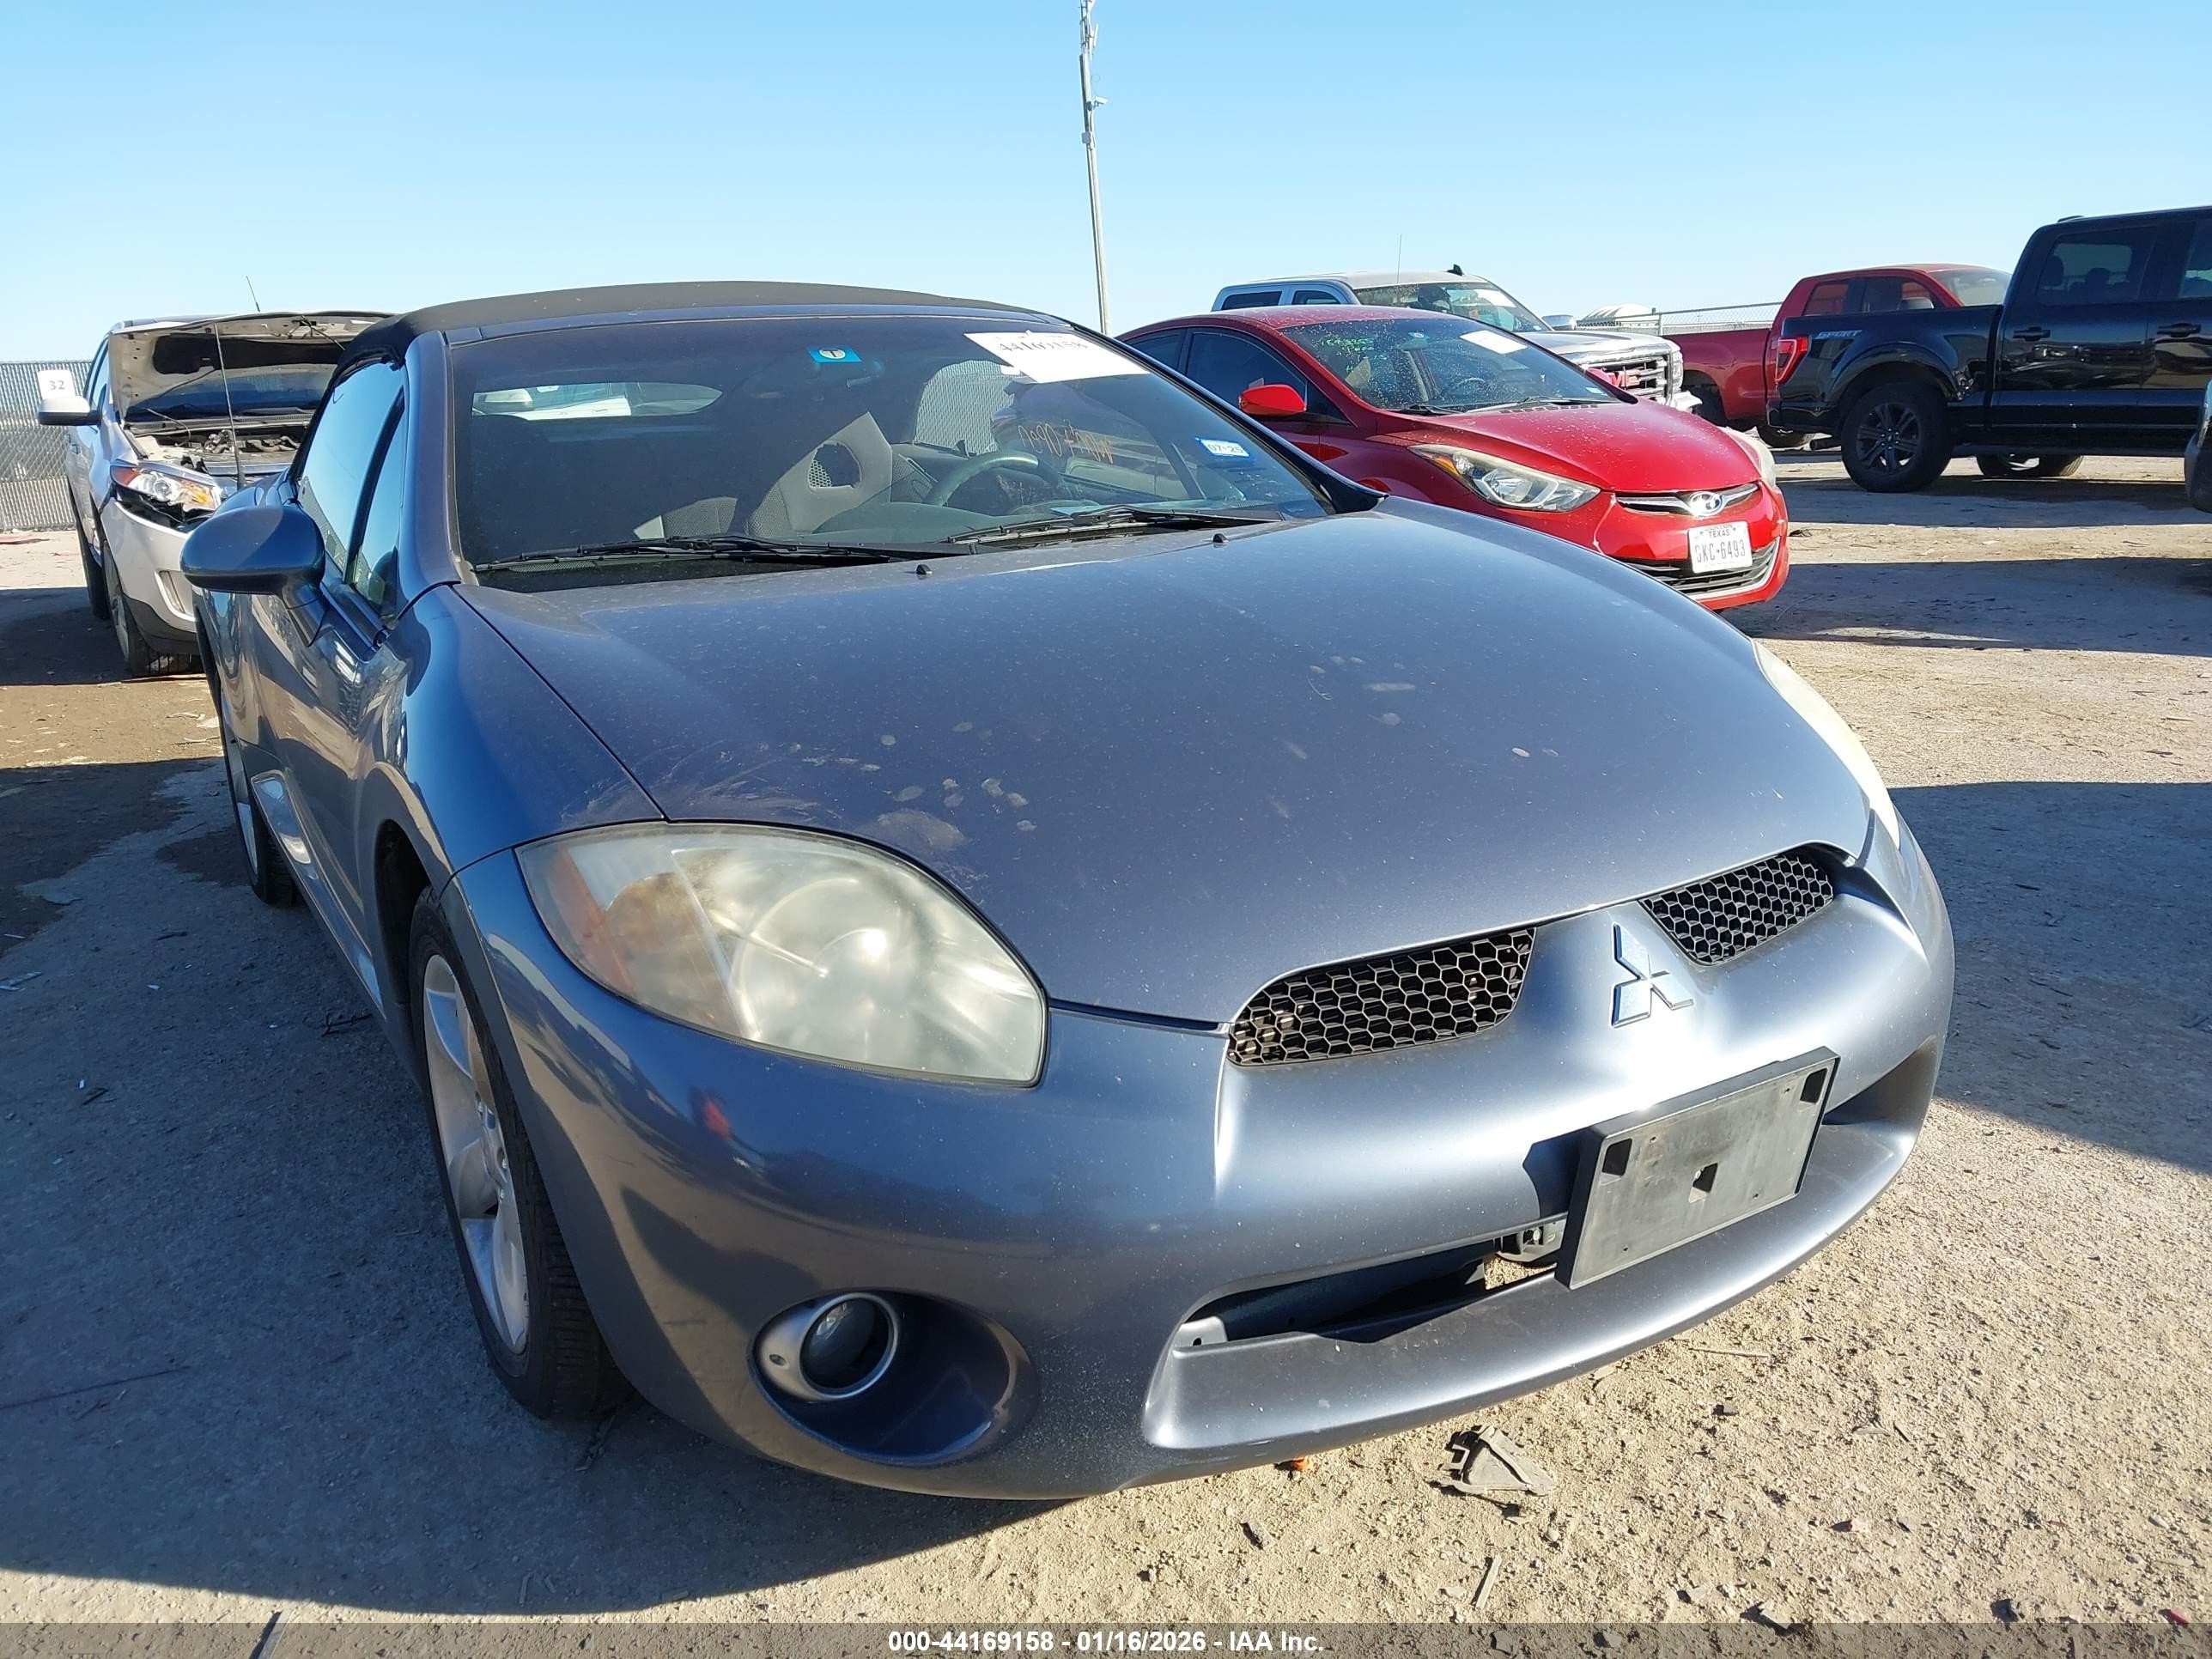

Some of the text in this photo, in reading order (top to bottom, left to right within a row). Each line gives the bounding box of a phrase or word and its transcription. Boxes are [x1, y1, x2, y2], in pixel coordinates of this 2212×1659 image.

[1814, 330, 1863, 339] SPORT
[49, 380, 65, 390] 32
[1708, 528, 1730, 538] TEXAS
